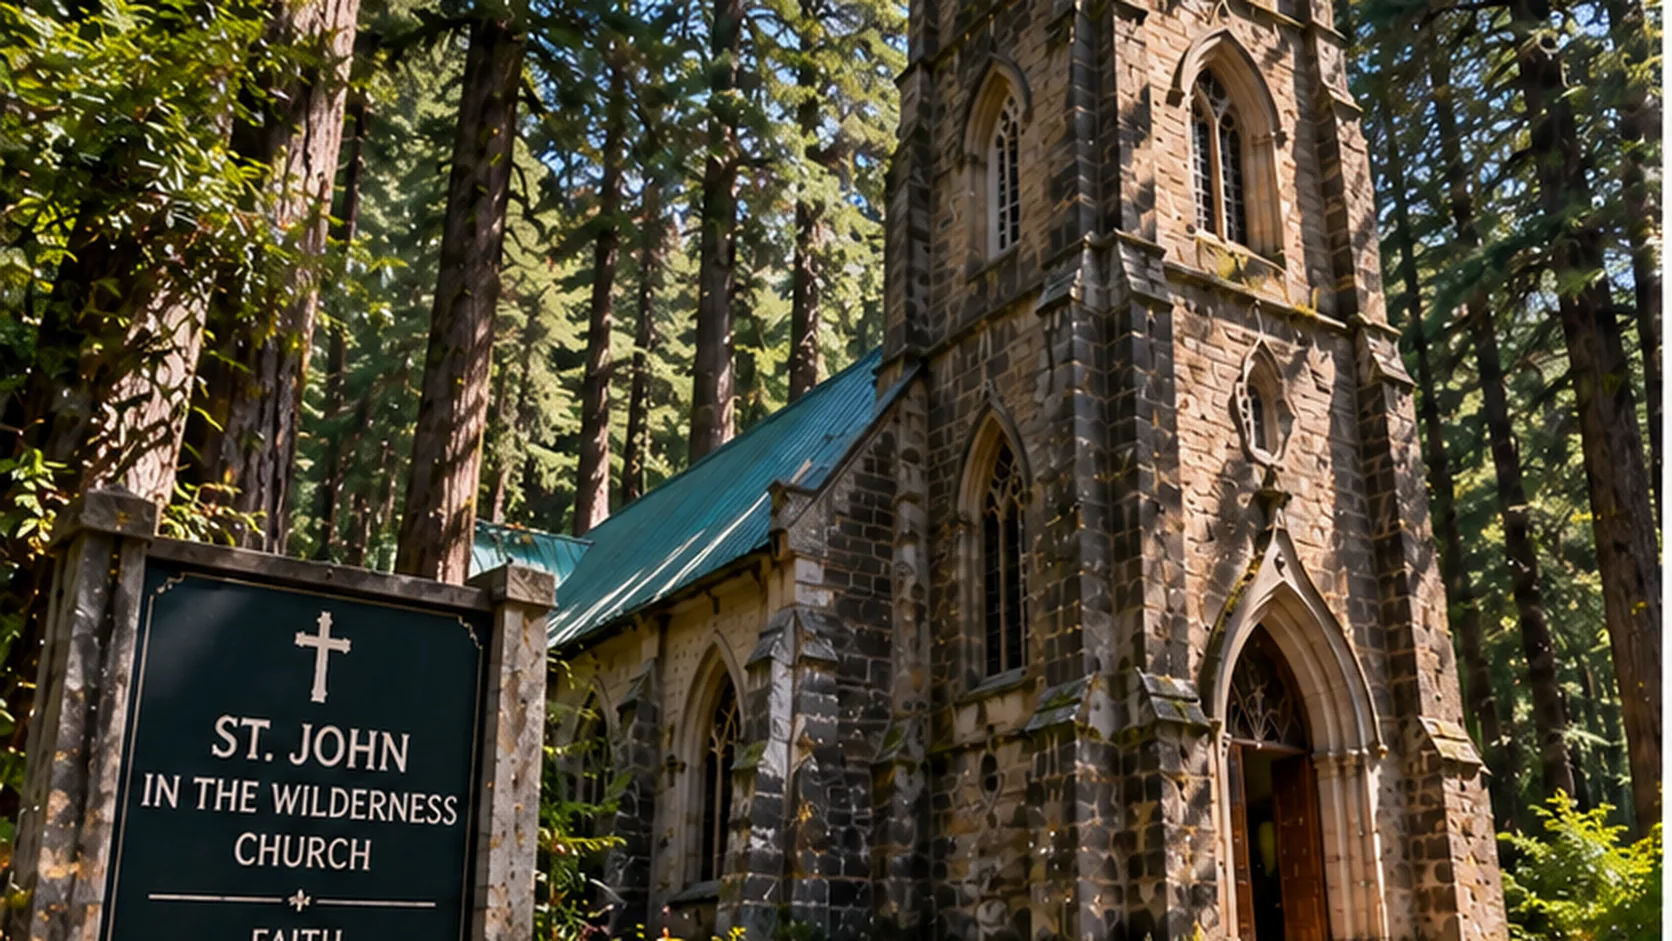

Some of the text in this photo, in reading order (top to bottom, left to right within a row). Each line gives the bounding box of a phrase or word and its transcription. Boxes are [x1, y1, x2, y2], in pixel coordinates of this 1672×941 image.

[211, 714, 410, 773] ST. JOHN
[141, 773, 458, 826] IN THE WILDERNESS
[234, 832, 372, 871] CHURCH
